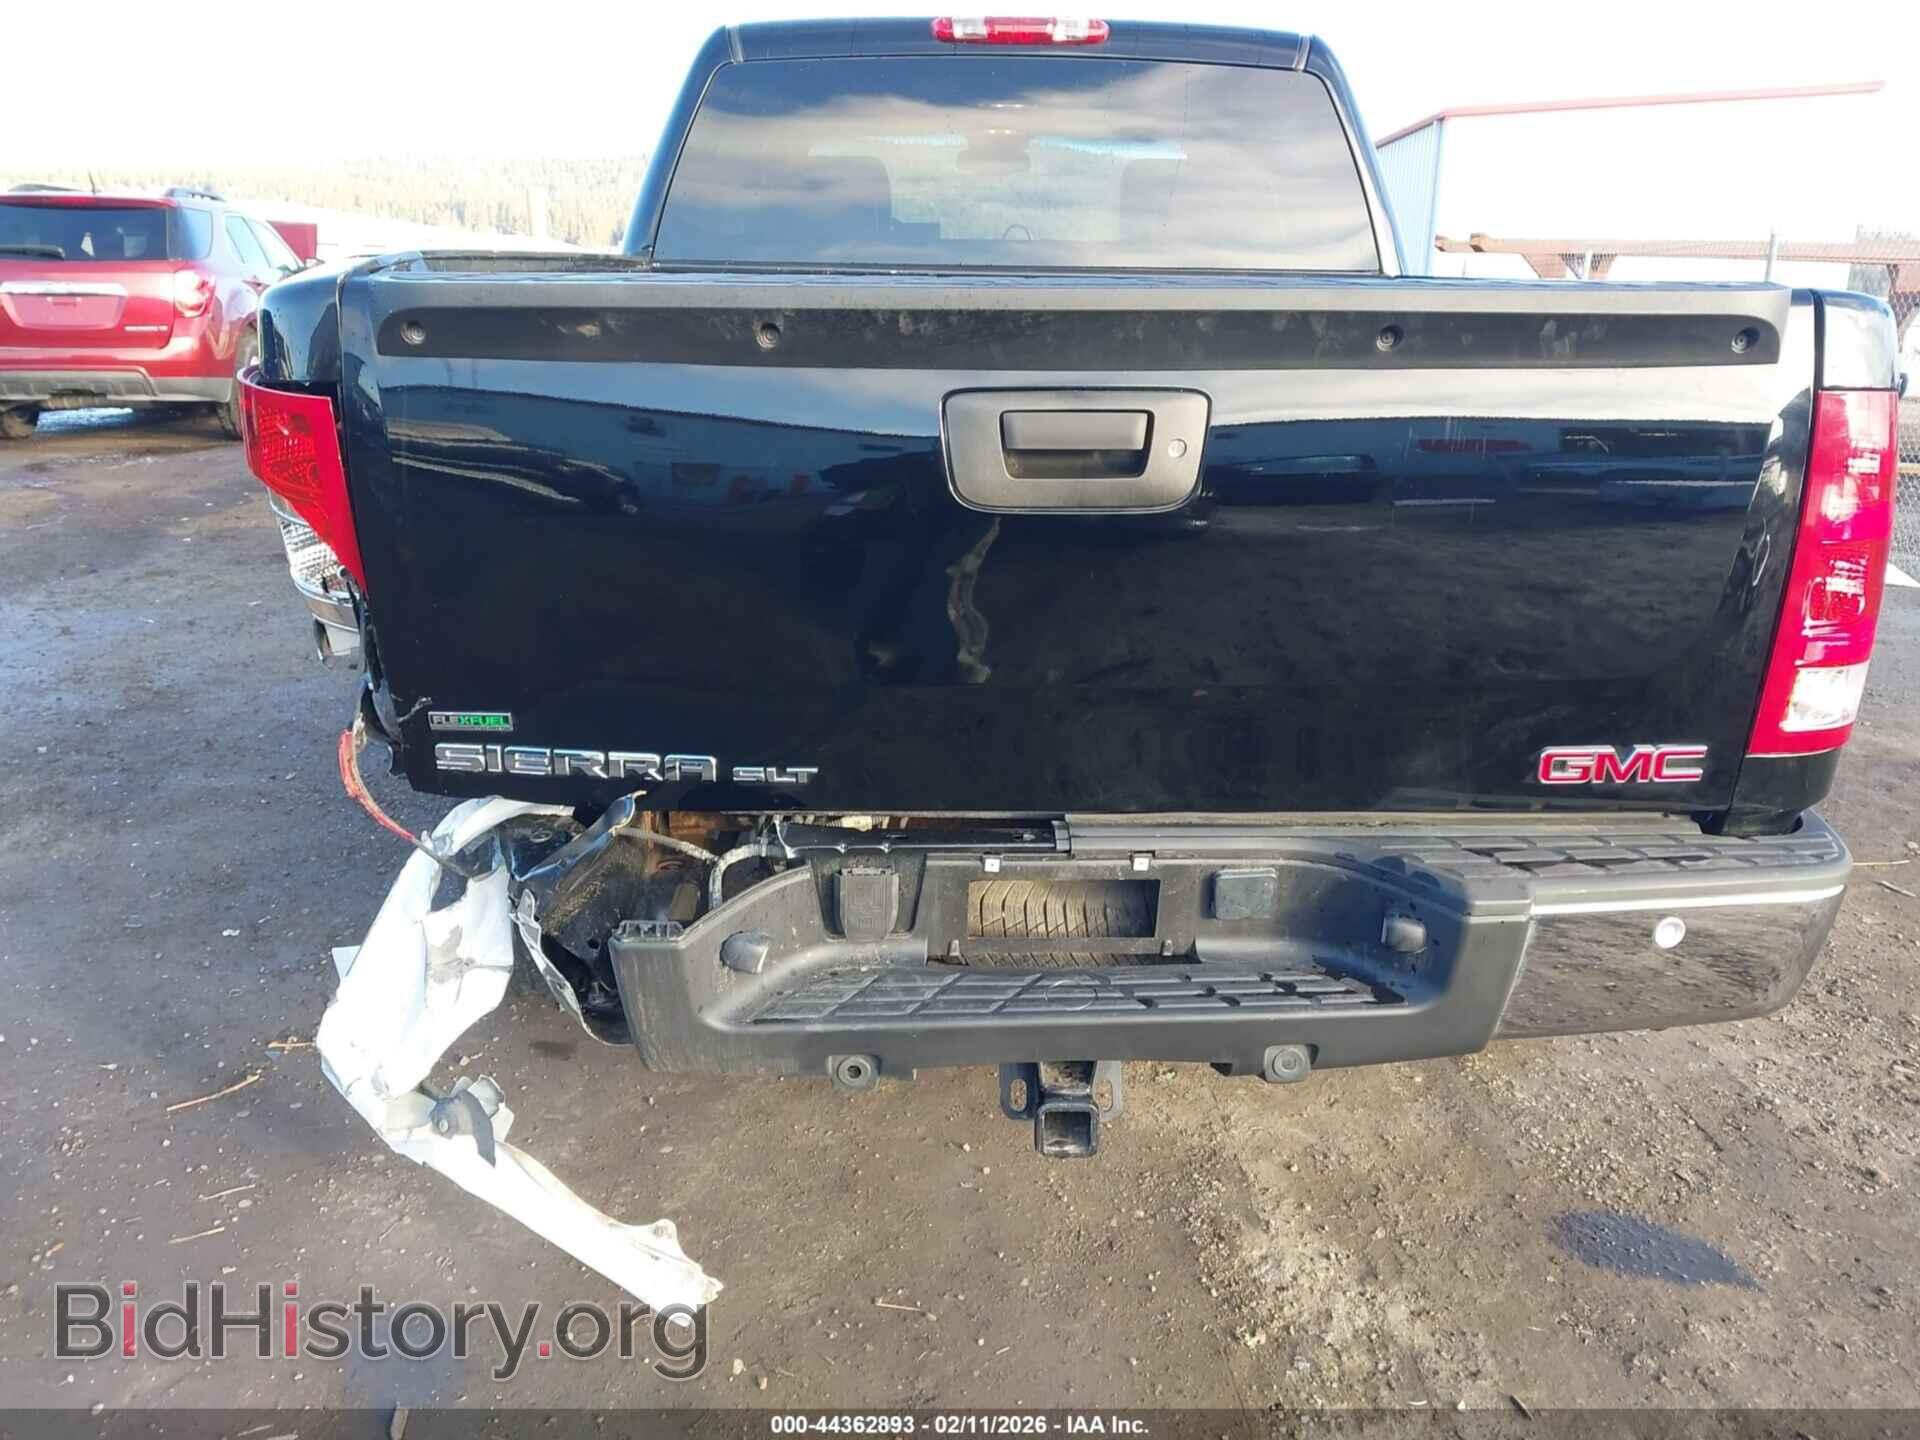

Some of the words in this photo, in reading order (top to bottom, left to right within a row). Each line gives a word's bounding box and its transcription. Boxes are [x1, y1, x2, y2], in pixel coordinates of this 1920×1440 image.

[431, 714, 511, 727] FLEXFUEL
[435, 743, 717, 783] SIERRA
[732, 767, 818, 783] SLT
[1538, 745, 1708, 784] GMC
